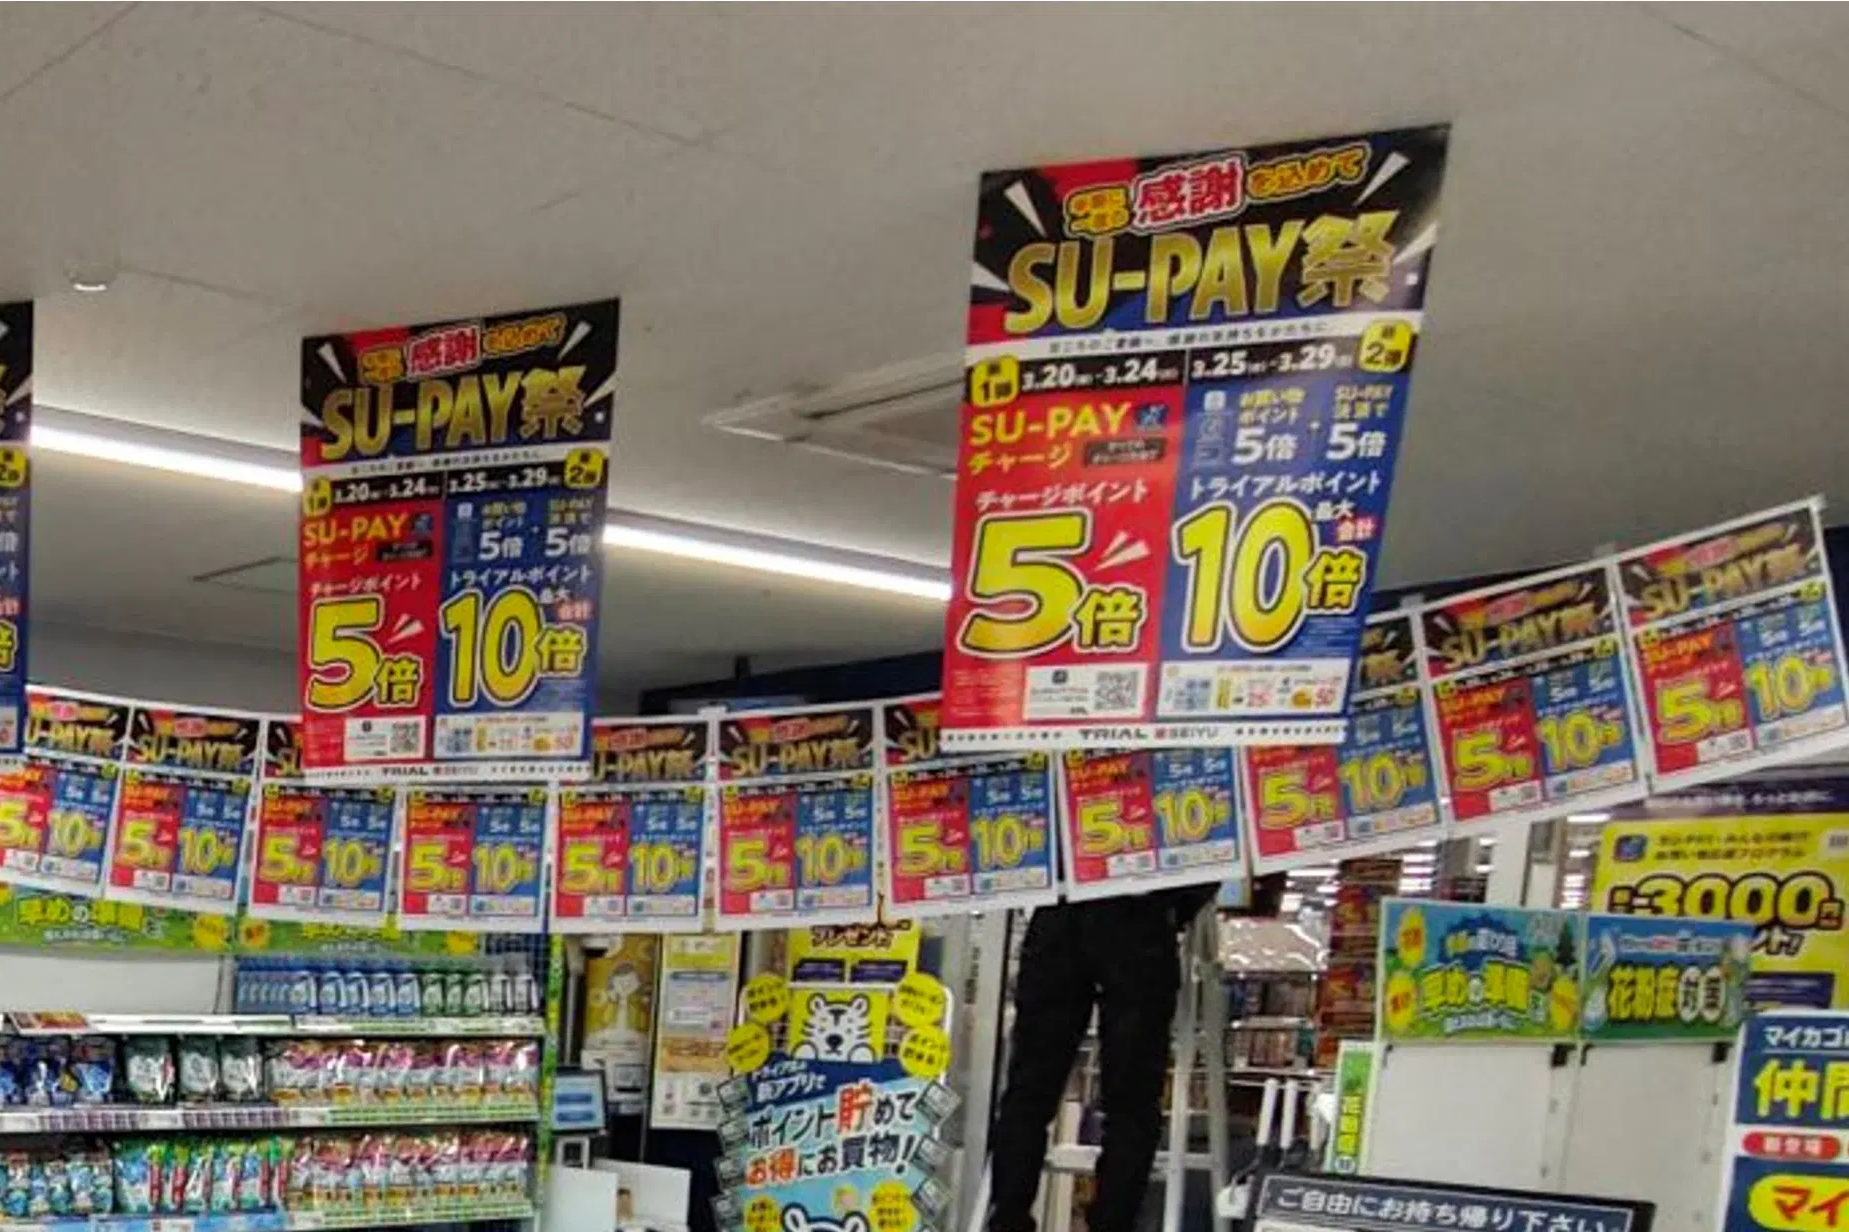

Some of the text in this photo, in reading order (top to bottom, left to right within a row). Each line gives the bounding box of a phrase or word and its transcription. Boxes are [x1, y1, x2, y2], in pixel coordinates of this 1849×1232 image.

[1136, 155, 1242, 228] 感謝
[1006, 209, 1398, 335] SU-PAY祭
[320, 364, 587, 461] SU-PAY祭
[969, 402, 1128, 447] SU-PAY
[968, 442, 1072, 475] チャージ
[1230, 426, 1299, 466] 5倍
[1325, 422, 1387, 461] 5倍
[976, 484, 1149, 511] チャージポイント
[1191, 470, 1381, 500] トライアルポイント
[302, 511, 408, 547] SU-PAY
[477, 526, 593, 561] 5倍 5倍
[310, 563, 593, 595] チャージポイント トライアルポイント
[959, 498, 1367, 656] 5倍 10倍
[306, 586, 587, 712] 5倍 10倍
[1079, 726, 1149, 741] TRIAL
[751, 1082, 917, 1149] ポイント貯めて
